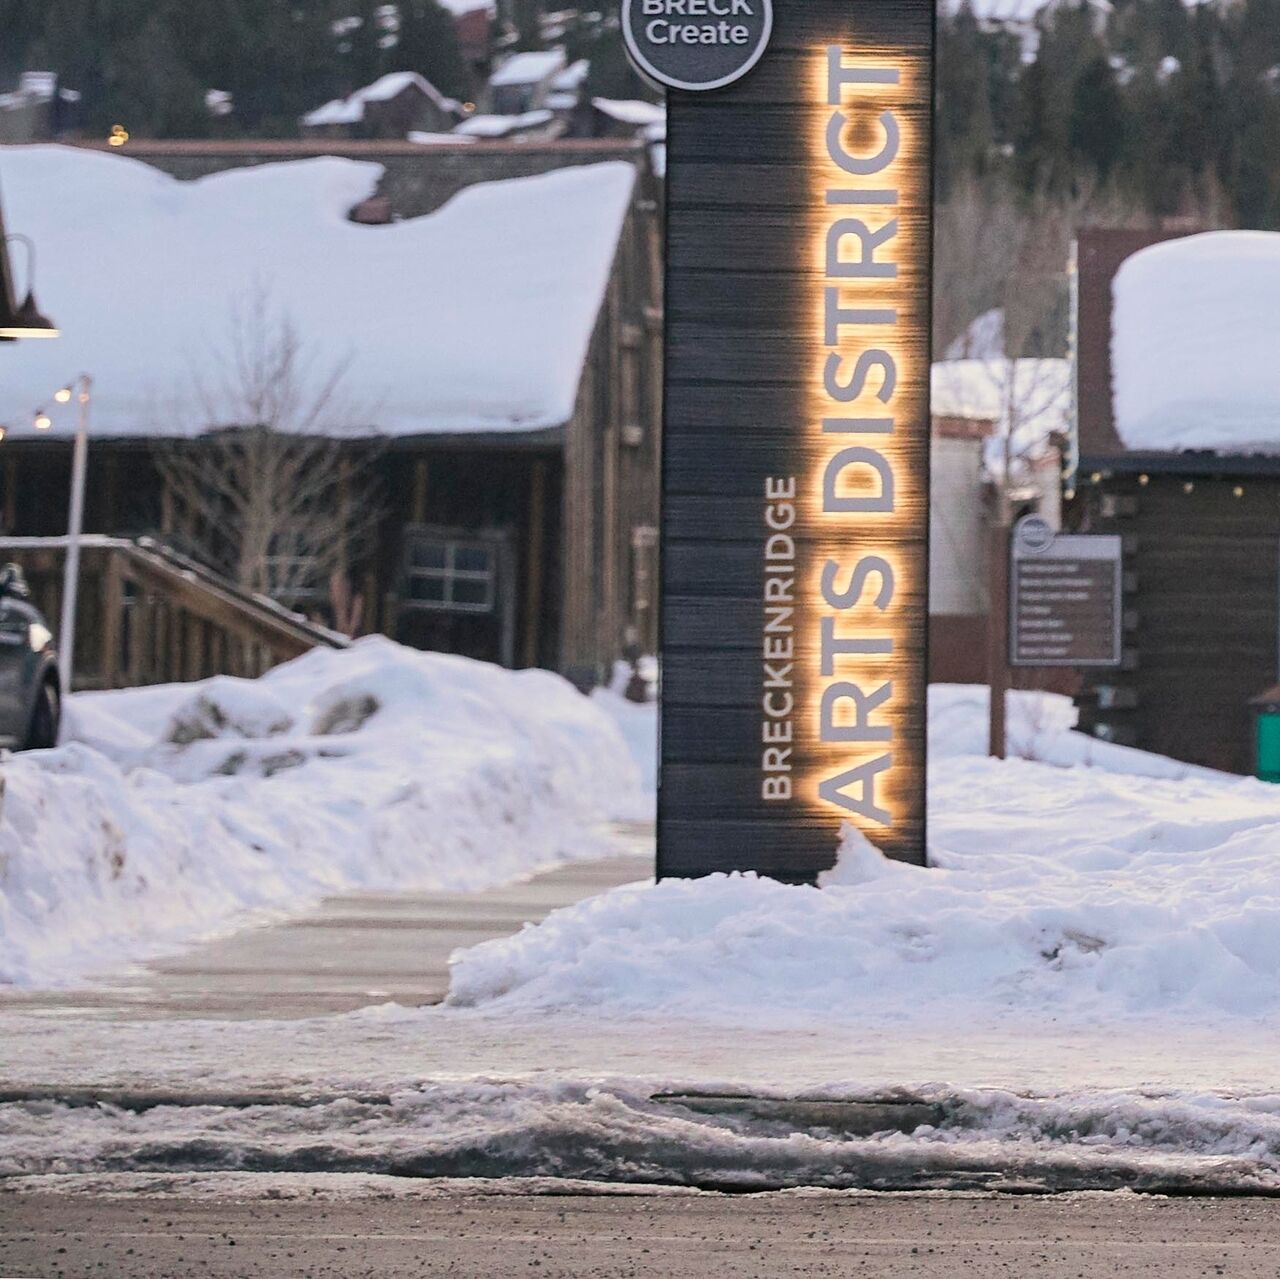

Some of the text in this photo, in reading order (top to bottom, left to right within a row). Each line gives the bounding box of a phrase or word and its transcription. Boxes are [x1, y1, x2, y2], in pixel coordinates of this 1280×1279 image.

[646, 19, 749, 44] Create
[818, 45, 900, 826] ARTS DISTRICT
[762, 477, 796, 800] BRECKENRIDGE
